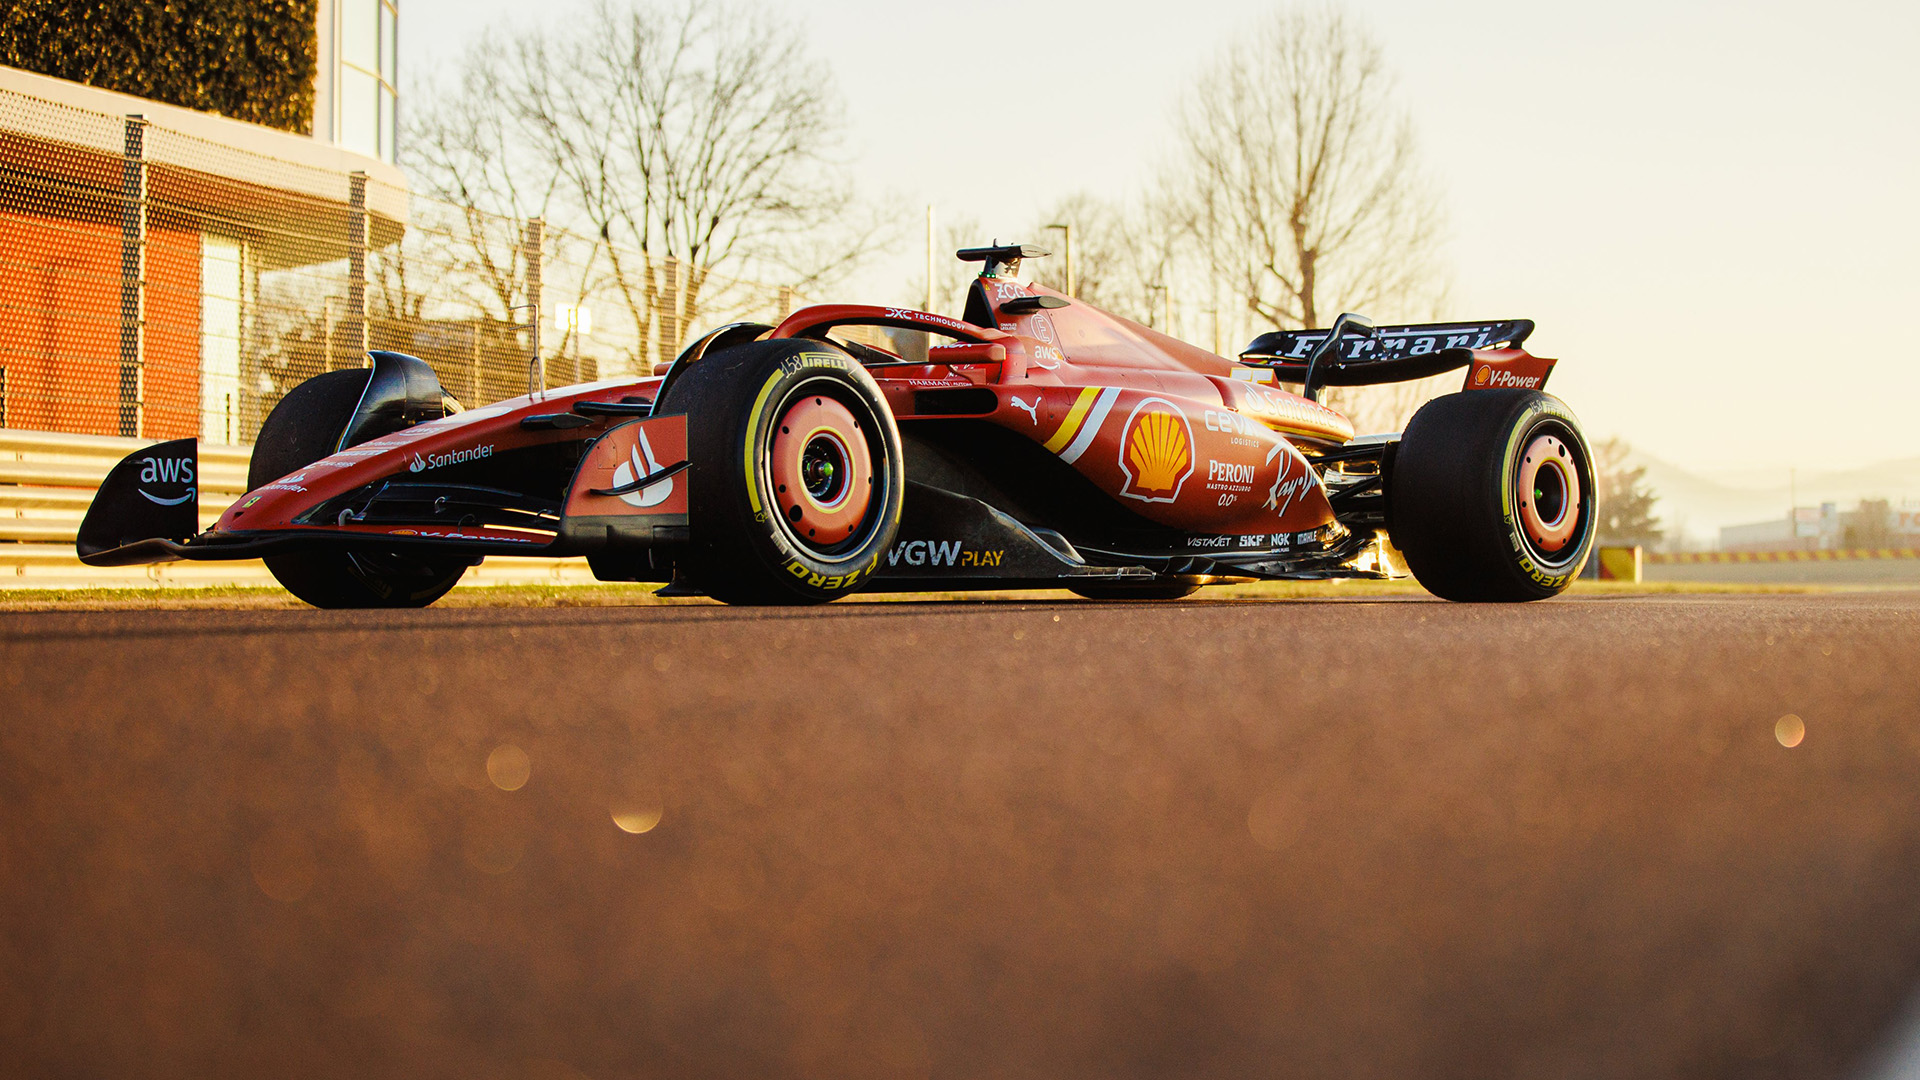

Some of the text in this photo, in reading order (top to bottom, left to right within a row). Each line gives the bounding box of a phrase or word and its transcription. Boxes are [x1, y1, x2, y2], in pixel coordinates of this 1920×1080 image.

[885, 307, 965, 330] DXC TECHNOLOGY
[1034, 345, 1058, 360] aws
[1284, 327, 1492, 359] Frrari
[781, 355, 802, 378] 158
[799, 352, 848, 370] PIRELLI
[1489, 369, 1540, 388] V-Power
[1264, 391, 1339, 429] Santander
[1230, 437, 1260, 448] LOGISTICS
[427, 444, 494, 470] Santander
[141, 457, 194, 483] aws
[1208, 459, 1255, 484] PERONI
[1239, 535, 1265, 547] SKF
[1270, 533, 1290, 547] NGK
[888, 541, 1004, 567] VGW PLAY
[786, 561, 861, 590] ZERO
[1519, 557, 1566, 588] ZERO
